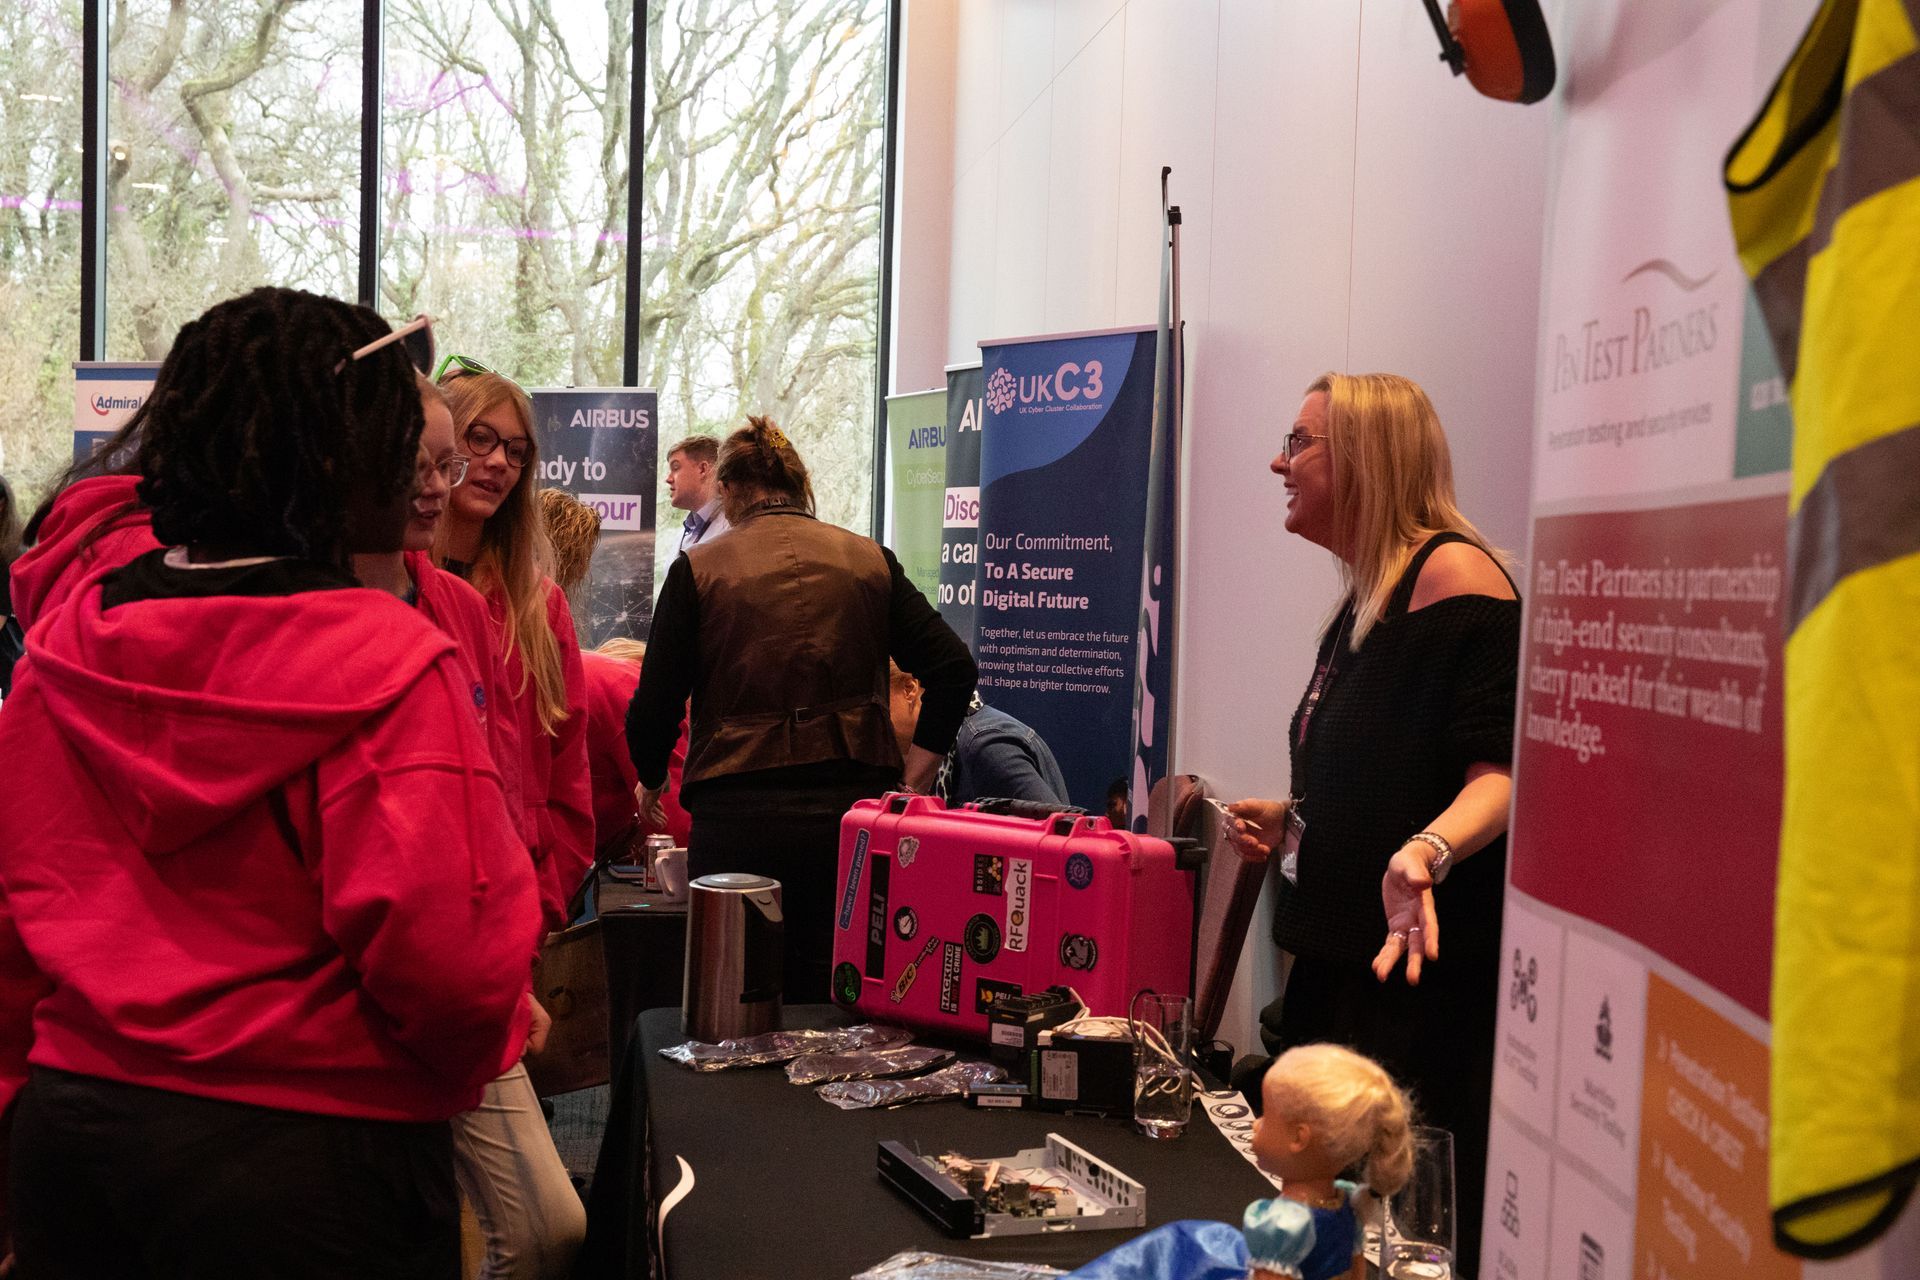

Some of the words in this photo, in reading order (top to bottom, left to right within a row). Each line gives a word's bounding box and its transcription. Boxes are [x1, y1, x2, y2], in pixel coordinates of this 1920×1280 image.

[96, 396, 142, 409] Admiral
[1028, 406, 1045, 415] Cyber
[1045, 404, 1065, 413] Cluster
[1066, 402, 1103, 412] Collaboration
[570, 409, 650, 429] AIRBUS
[908, 426, 946, 449] AIRBU
[1587, 422, 1623, 448] testing
[1626, 418, 1645, 440] and
[582, 456, 607, 481] to
[945, 494, 980, 521] Disc
[985, 534, 1012, 551] Our
[1015, 532, 1114, 553] Commitment,
[942, 543, 949, 564] a
[985, 563, 1004, 580] To
[1007, 563, 1019, 580] A
[1021, 563, 1074, 581] Secure
[1558, 559, 1588, 597] Test
[1590, 559, 1660, 600] Partners
[983, 590, 1035, 610] Digital
[1038, 592, 1089, 609] Future
[980, 627, 1022, 641] Together,
[1023, 629, 1034, 640] let
[1036, 632, 1045, 640] us
[1048, 630, 1084, 642] embrace
[1087, 631, 1101, 643] the
[1103, 632, 1129, 643] future
[1547, 607, 1615, 656] high-end
[1616, 613, 1676, 662] security
[979, 643, 997, 654] with
[1000, 645, 1040, 657] optimism
[1042, 646, 1056, 657] and
[1059, 648, 1122, 661] determination,
[978, 660, 1014, 675] knowing
[1016, 661, 1033, 672] that
[1035, 664, 1049, 673] our
[1052, 663, 1092, 676] collective
[1094, 666, 1125, 678] efforts
[978, 676, 993, 687] will
[994, 677, 1020, 691] shape
[1030, 679, 1063, 693] brighter
[1064, 683, 1111, 694] tomorrow.
[1570, 660, 1630, 709] picked
[1631, 664, 1652, 710] for
[1744, 683, 1767, 735] of
[1009, 862, 1028, 950] RFQuack
[871, 893, 886, 945] PELI
[954, 946, 962, 974] CRIME
[941, 943, 953, 1010] HACKING
[953, 974, 960, 982] A
[994, 992, 1011, 1001] PELI
[950, 1003, 957, 1012] IS
